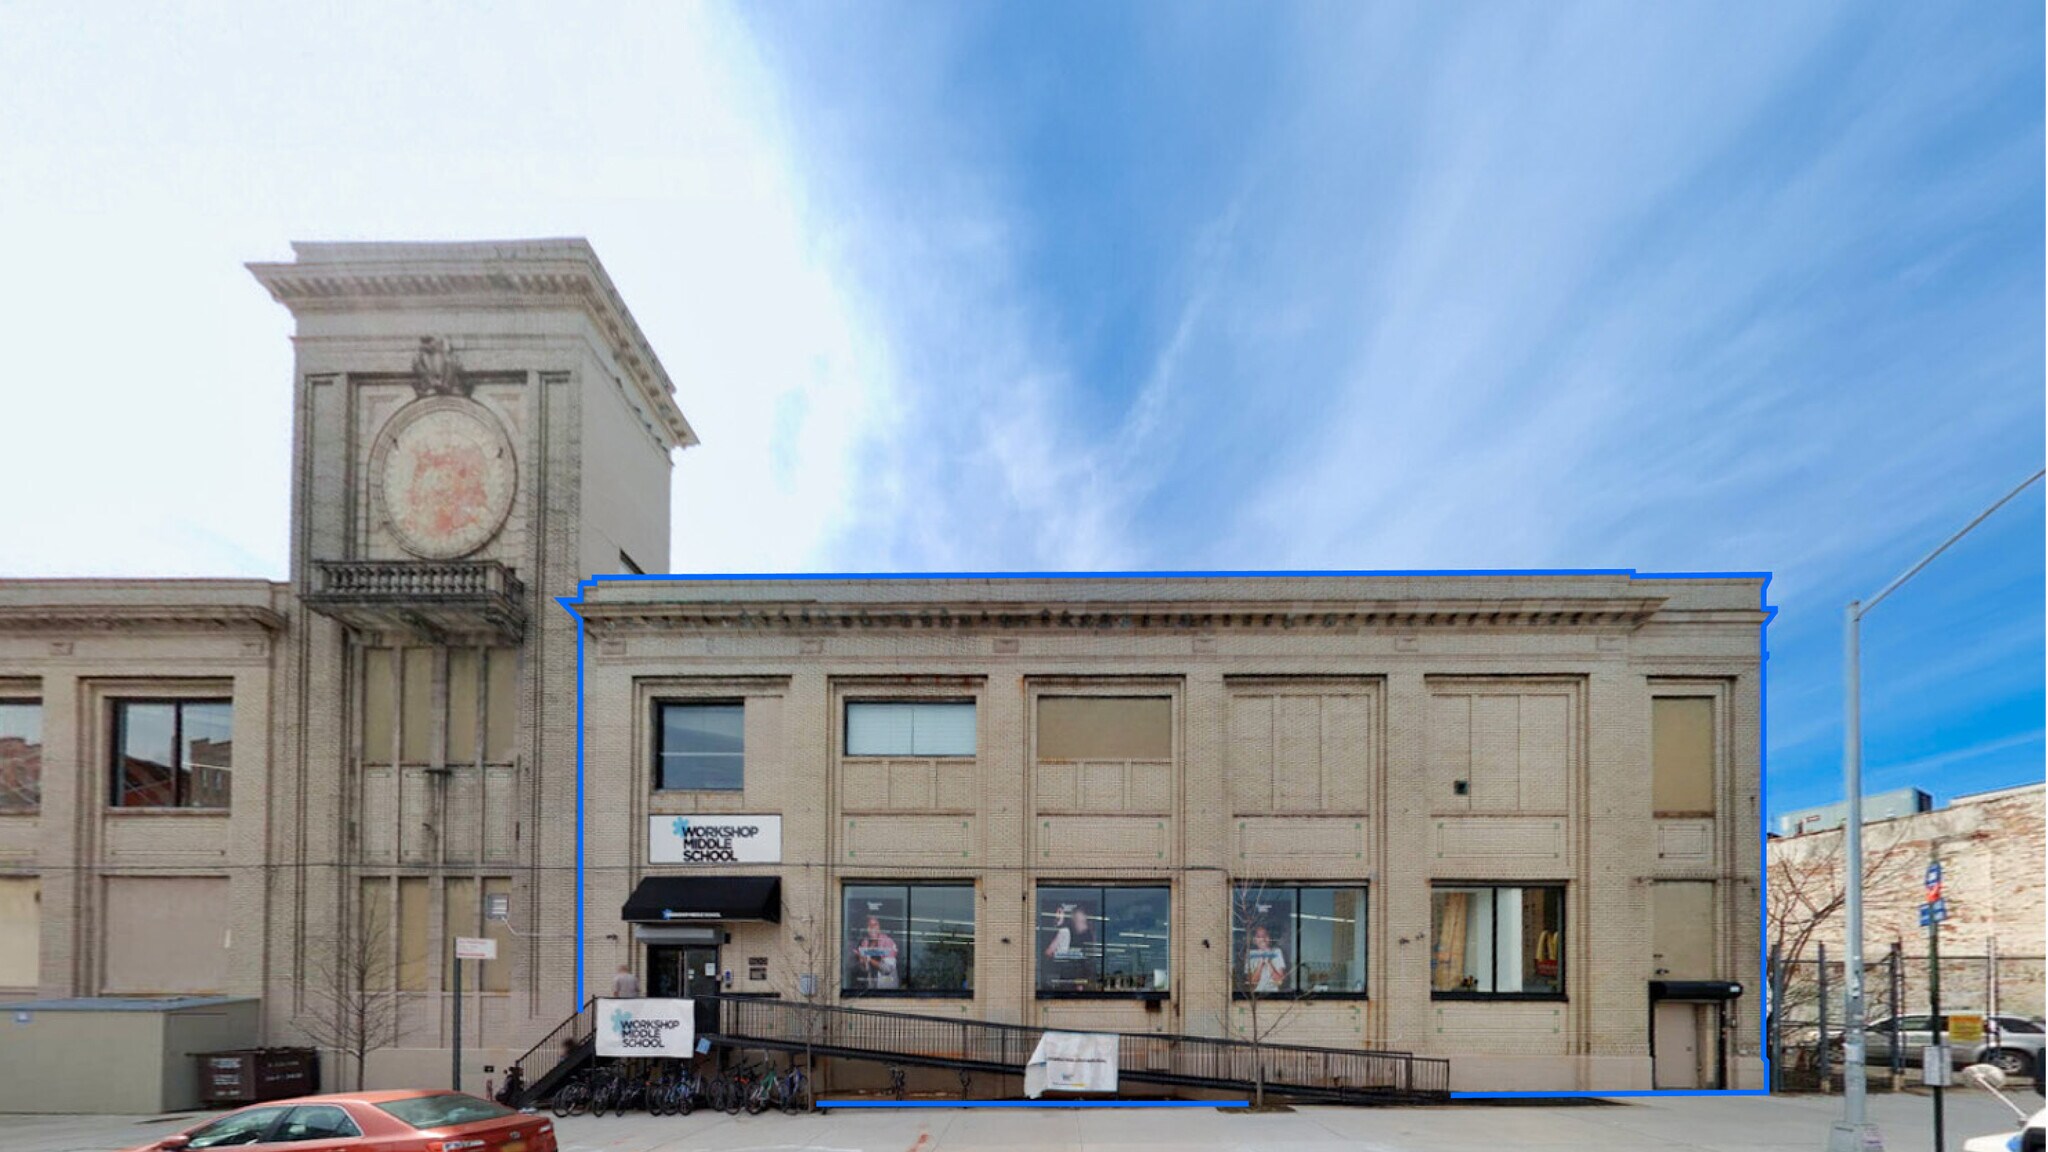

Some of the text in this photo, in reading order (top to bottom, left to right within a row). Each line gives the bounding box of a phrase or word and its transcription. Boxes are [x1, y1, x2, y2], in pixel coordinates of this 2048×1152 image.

[682, 826, 759, 838] WORKSHOP
[683, 838, 733, 849] MIDDLE
[683, 850, 738, 862] SCHOOL
[621, 1019, 680, 1030] WORKSHOP
[622, 1029, 661, 1038] MIDDLE
[623, 1039, 665, 1048] SCHOOL
